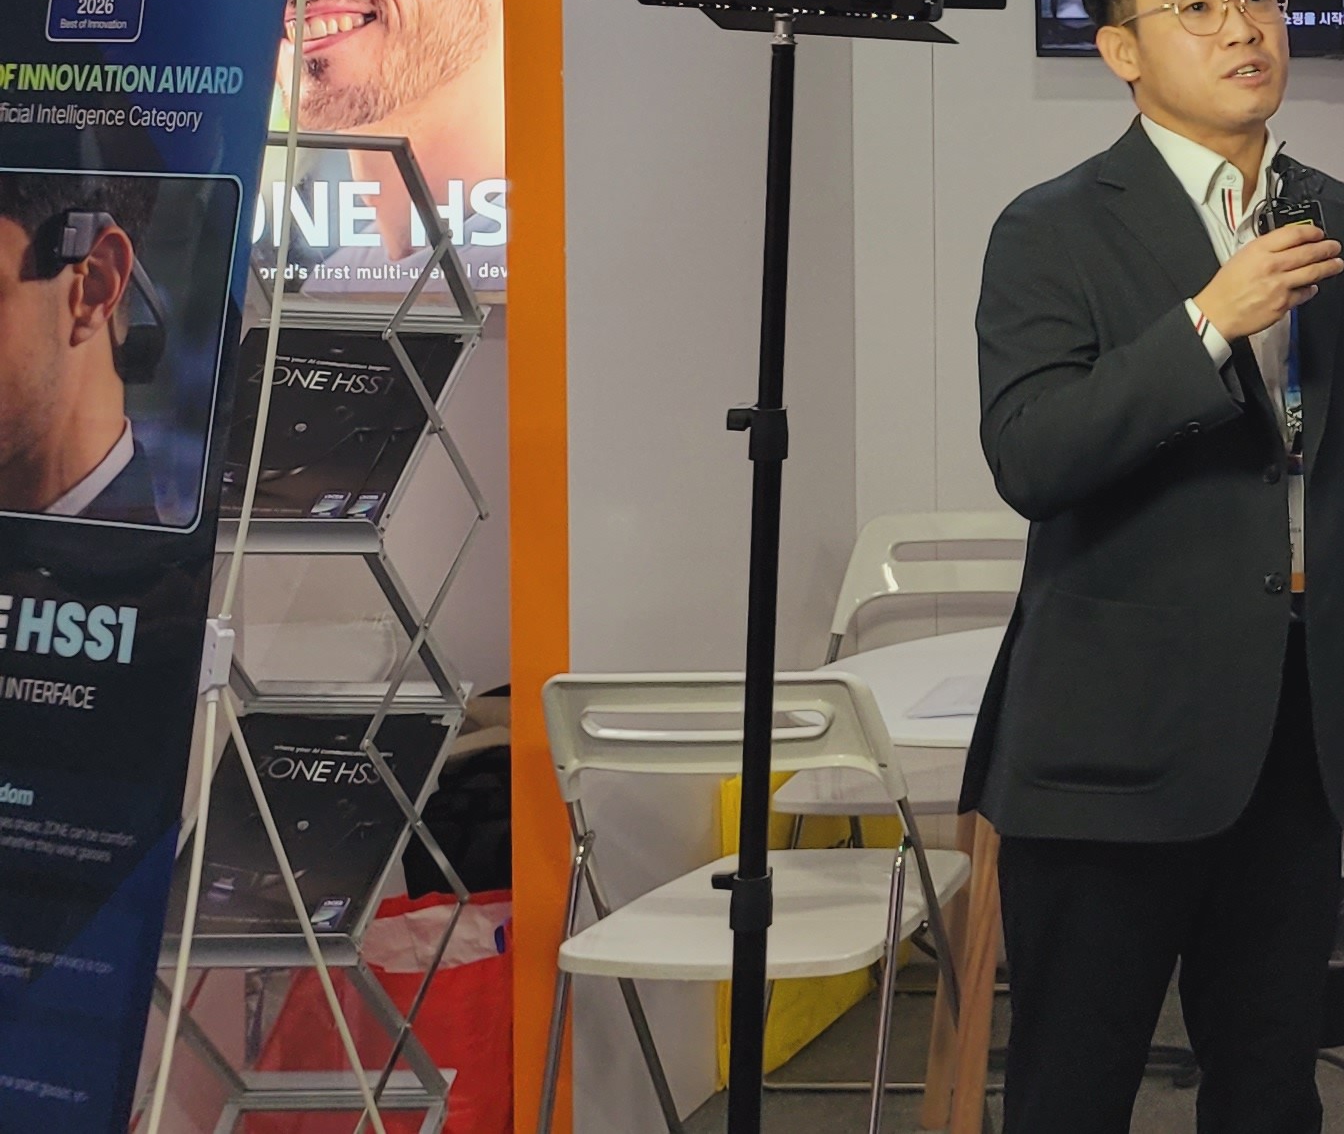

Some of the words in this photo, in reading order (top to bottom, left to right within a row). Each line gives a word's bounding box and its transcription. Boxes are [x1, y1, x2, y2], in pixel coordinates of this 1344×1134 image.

[87, 18, 128, 30] Innovation
[17, 63, 157, 93] INNOVATION
[157, 65, 244, 95] AWARD
[0, 101, 34, 124] ficial
[37, 102, 125, 131] Intelligence
[129, 105, 203, 133] Category
[314, 263, 350, 280] first
[14, 596, 138, 664] HSS1
[5, 676, 98, 710] INTERFACE
